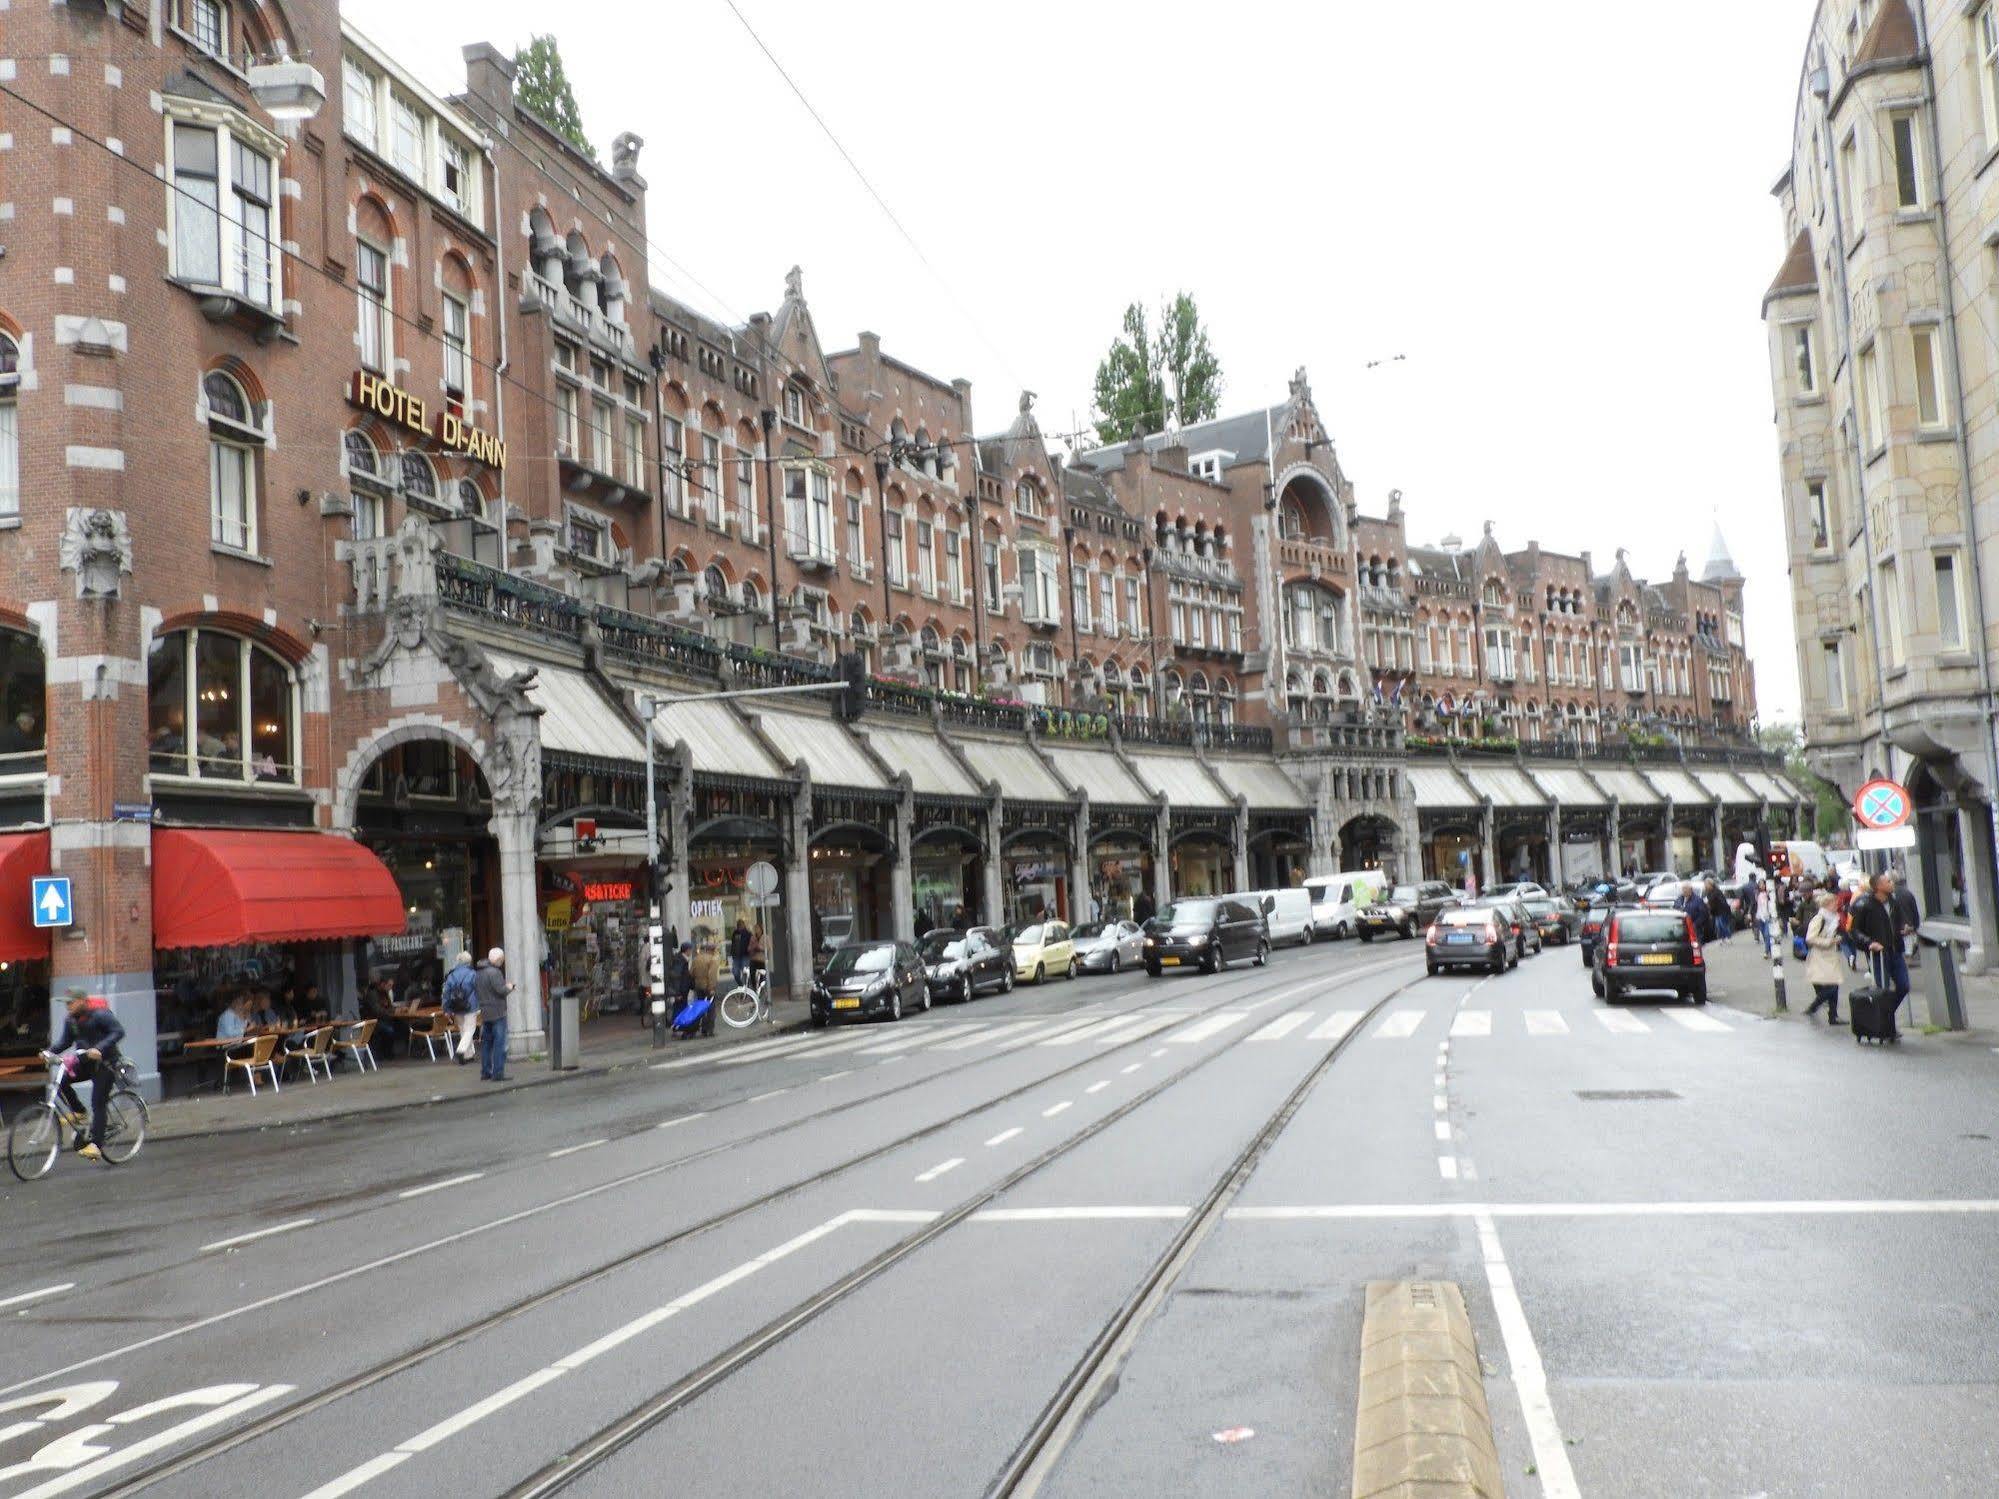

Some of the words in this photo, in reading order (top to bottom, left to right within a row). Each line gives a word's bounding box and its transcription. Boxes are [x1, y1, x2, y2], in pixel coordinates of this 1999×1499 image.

[359, 368, 434, 436] HOTEL
[442, 411, 507, 470] DI-ANN
[691, 900, 723, 917] OPTIEK
